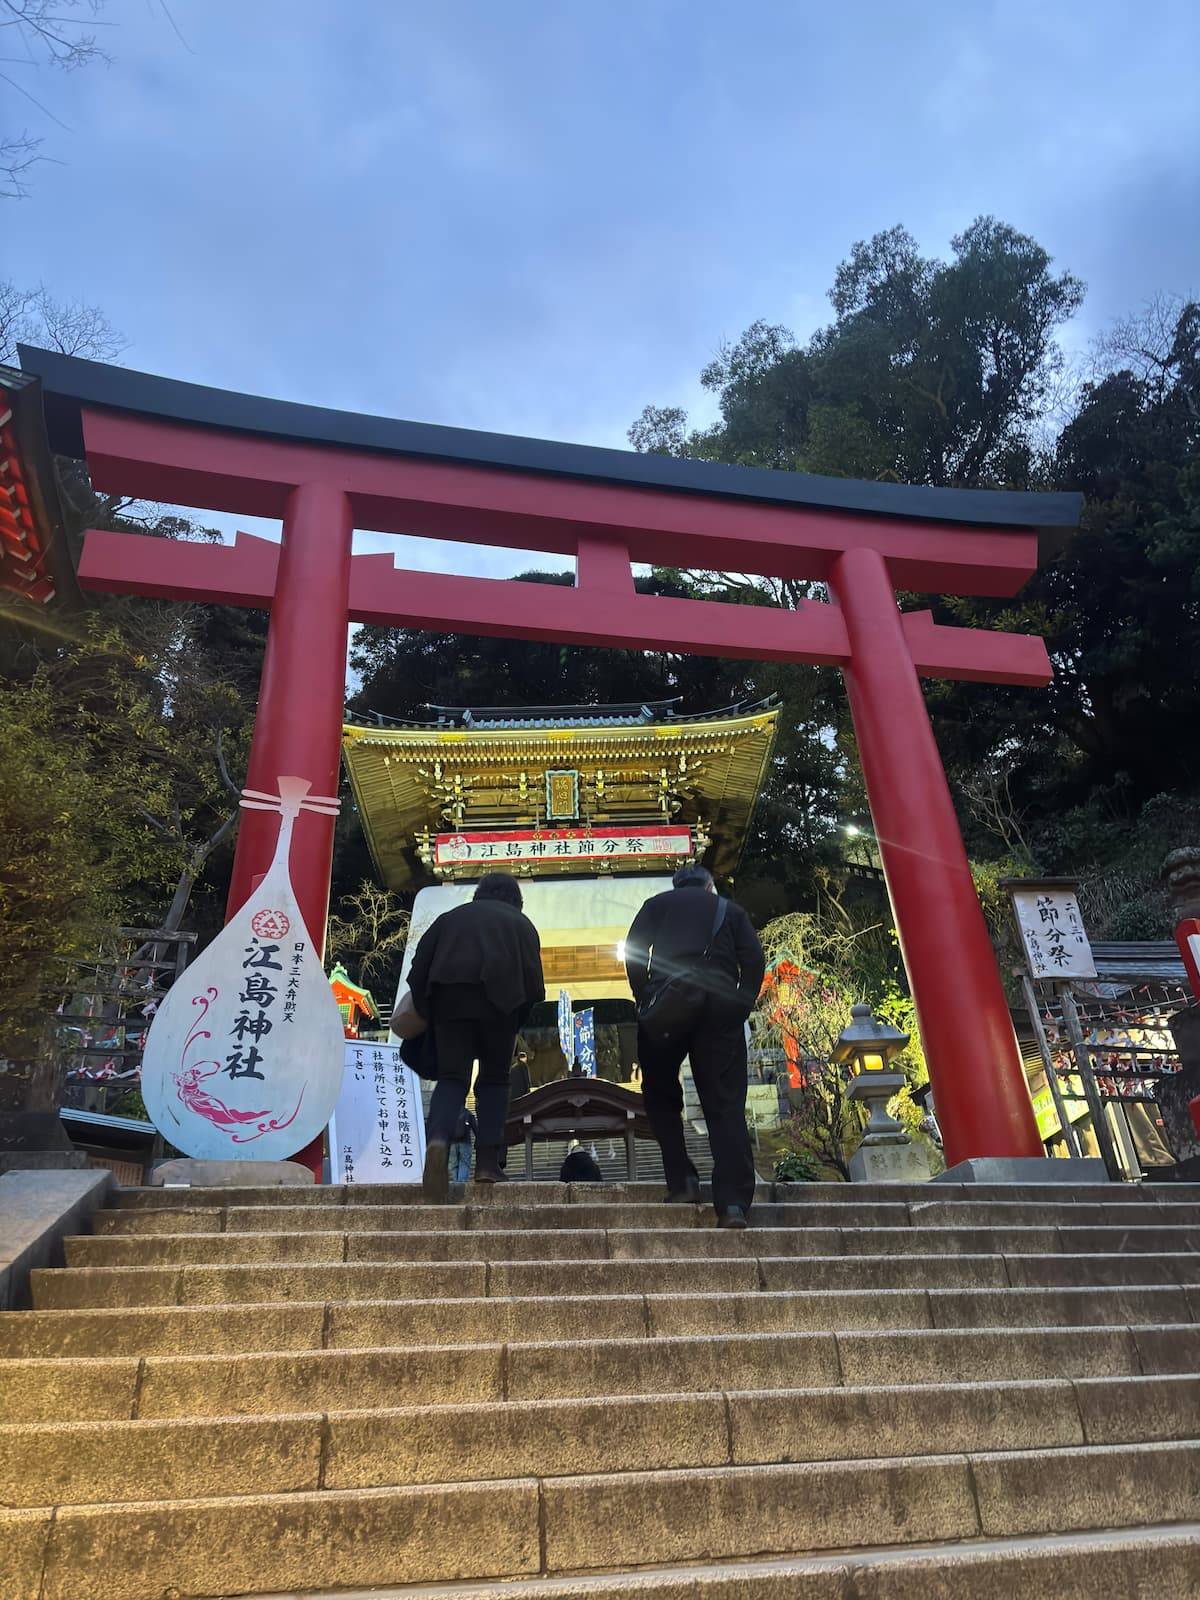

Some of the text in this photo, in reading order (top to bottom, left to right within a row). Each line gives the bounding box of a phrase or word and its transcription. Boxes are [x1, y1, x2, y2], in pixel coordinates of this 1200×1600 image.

[481, 838, 645, 857] 江島神社節分祭
[1037, 896, 1073, 968] 節分祭
[221, 937, 283, 1081] 江島神社
[282, 942, 305, 1024] 日本三大弁財天
[352, 1049, 366, 1081] 下さい
[372, 1050, 392, 1169] 社務所にてお申し込み
[343, 1144, 355, 1183] 江島神社
